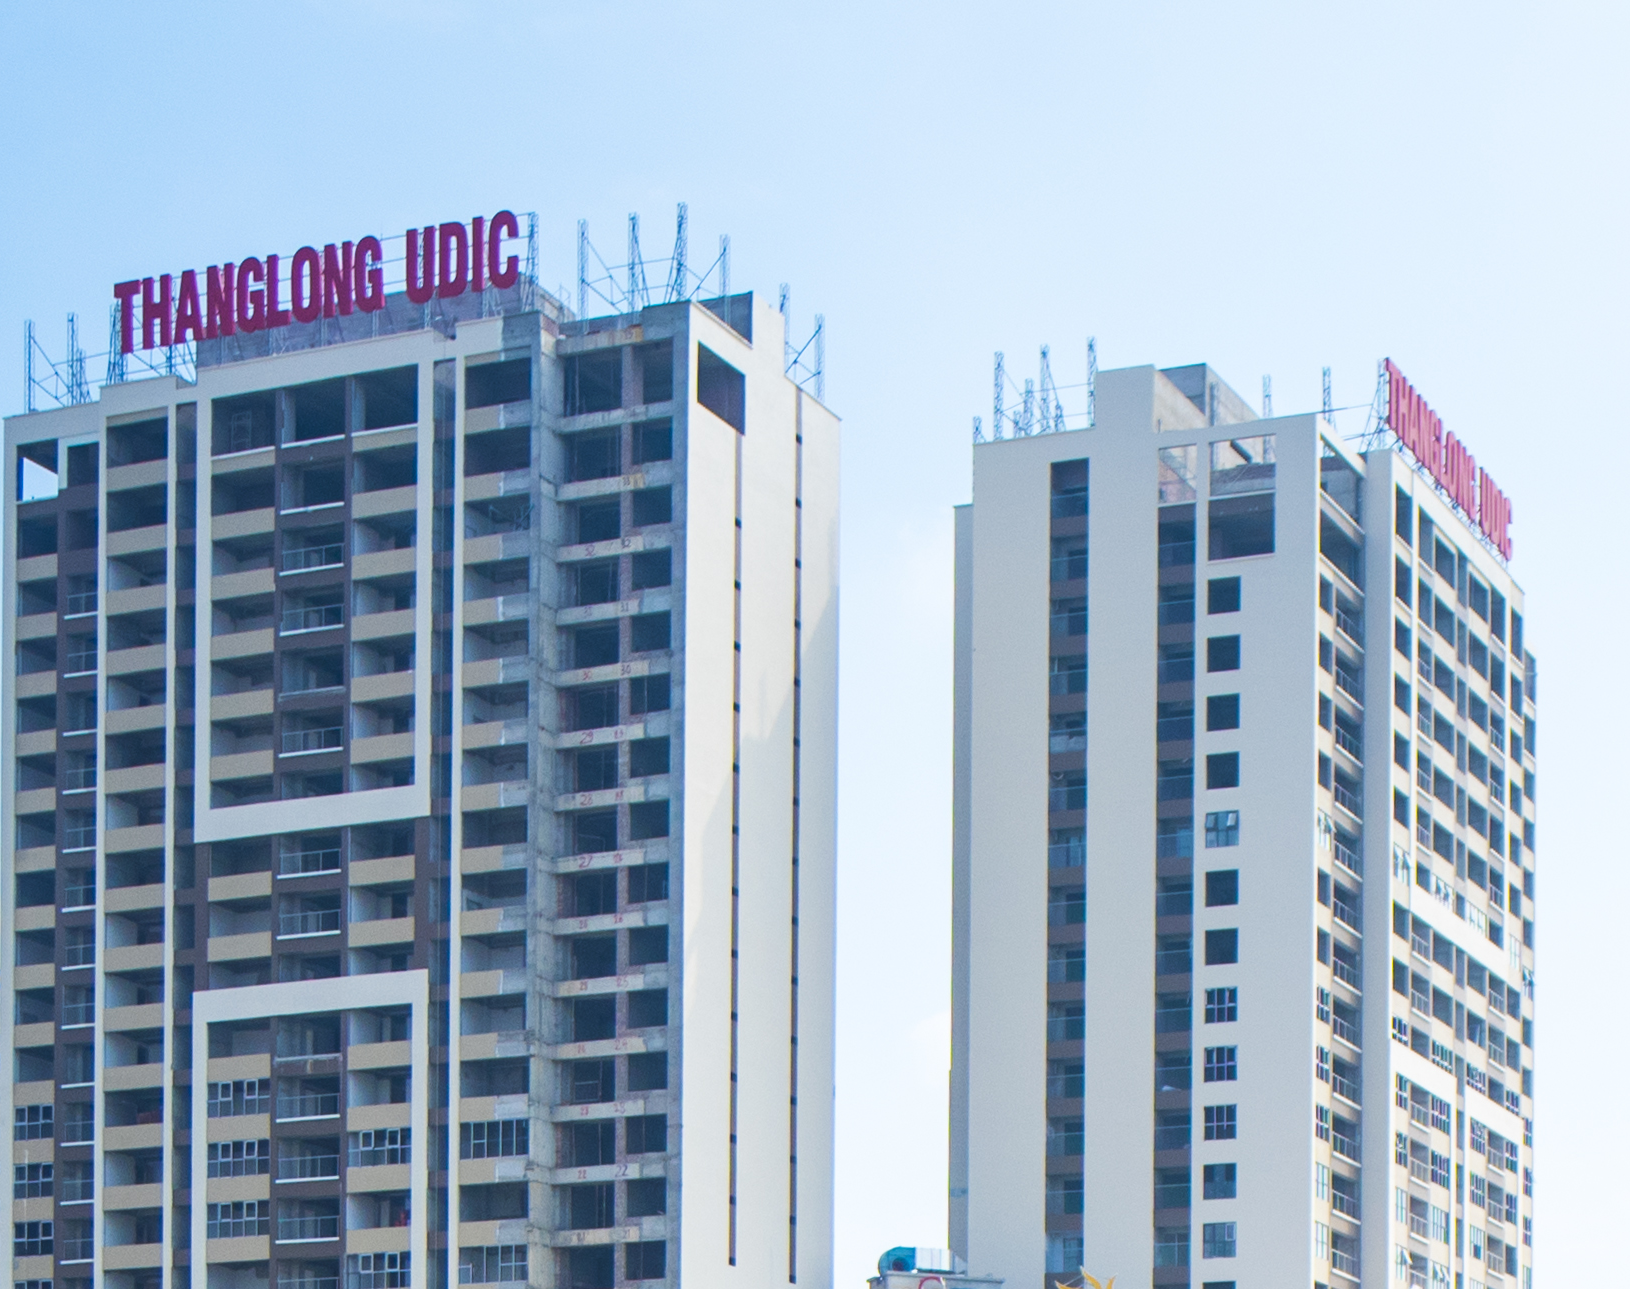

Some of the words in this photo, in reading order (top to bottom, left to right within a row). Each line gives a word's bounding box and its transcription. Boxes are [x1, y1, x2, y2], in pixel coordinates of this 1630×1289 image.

[113, 236, 386, 354] THANGLONG
[405, 210, 520, 305] UDIC
[1385, 357, 1477, 523] THANGLONG
[1479, 466, 1513, 562] UDIC
[620, 664, 631, 676] 30
[614, 1166, 628, 1177] 22
